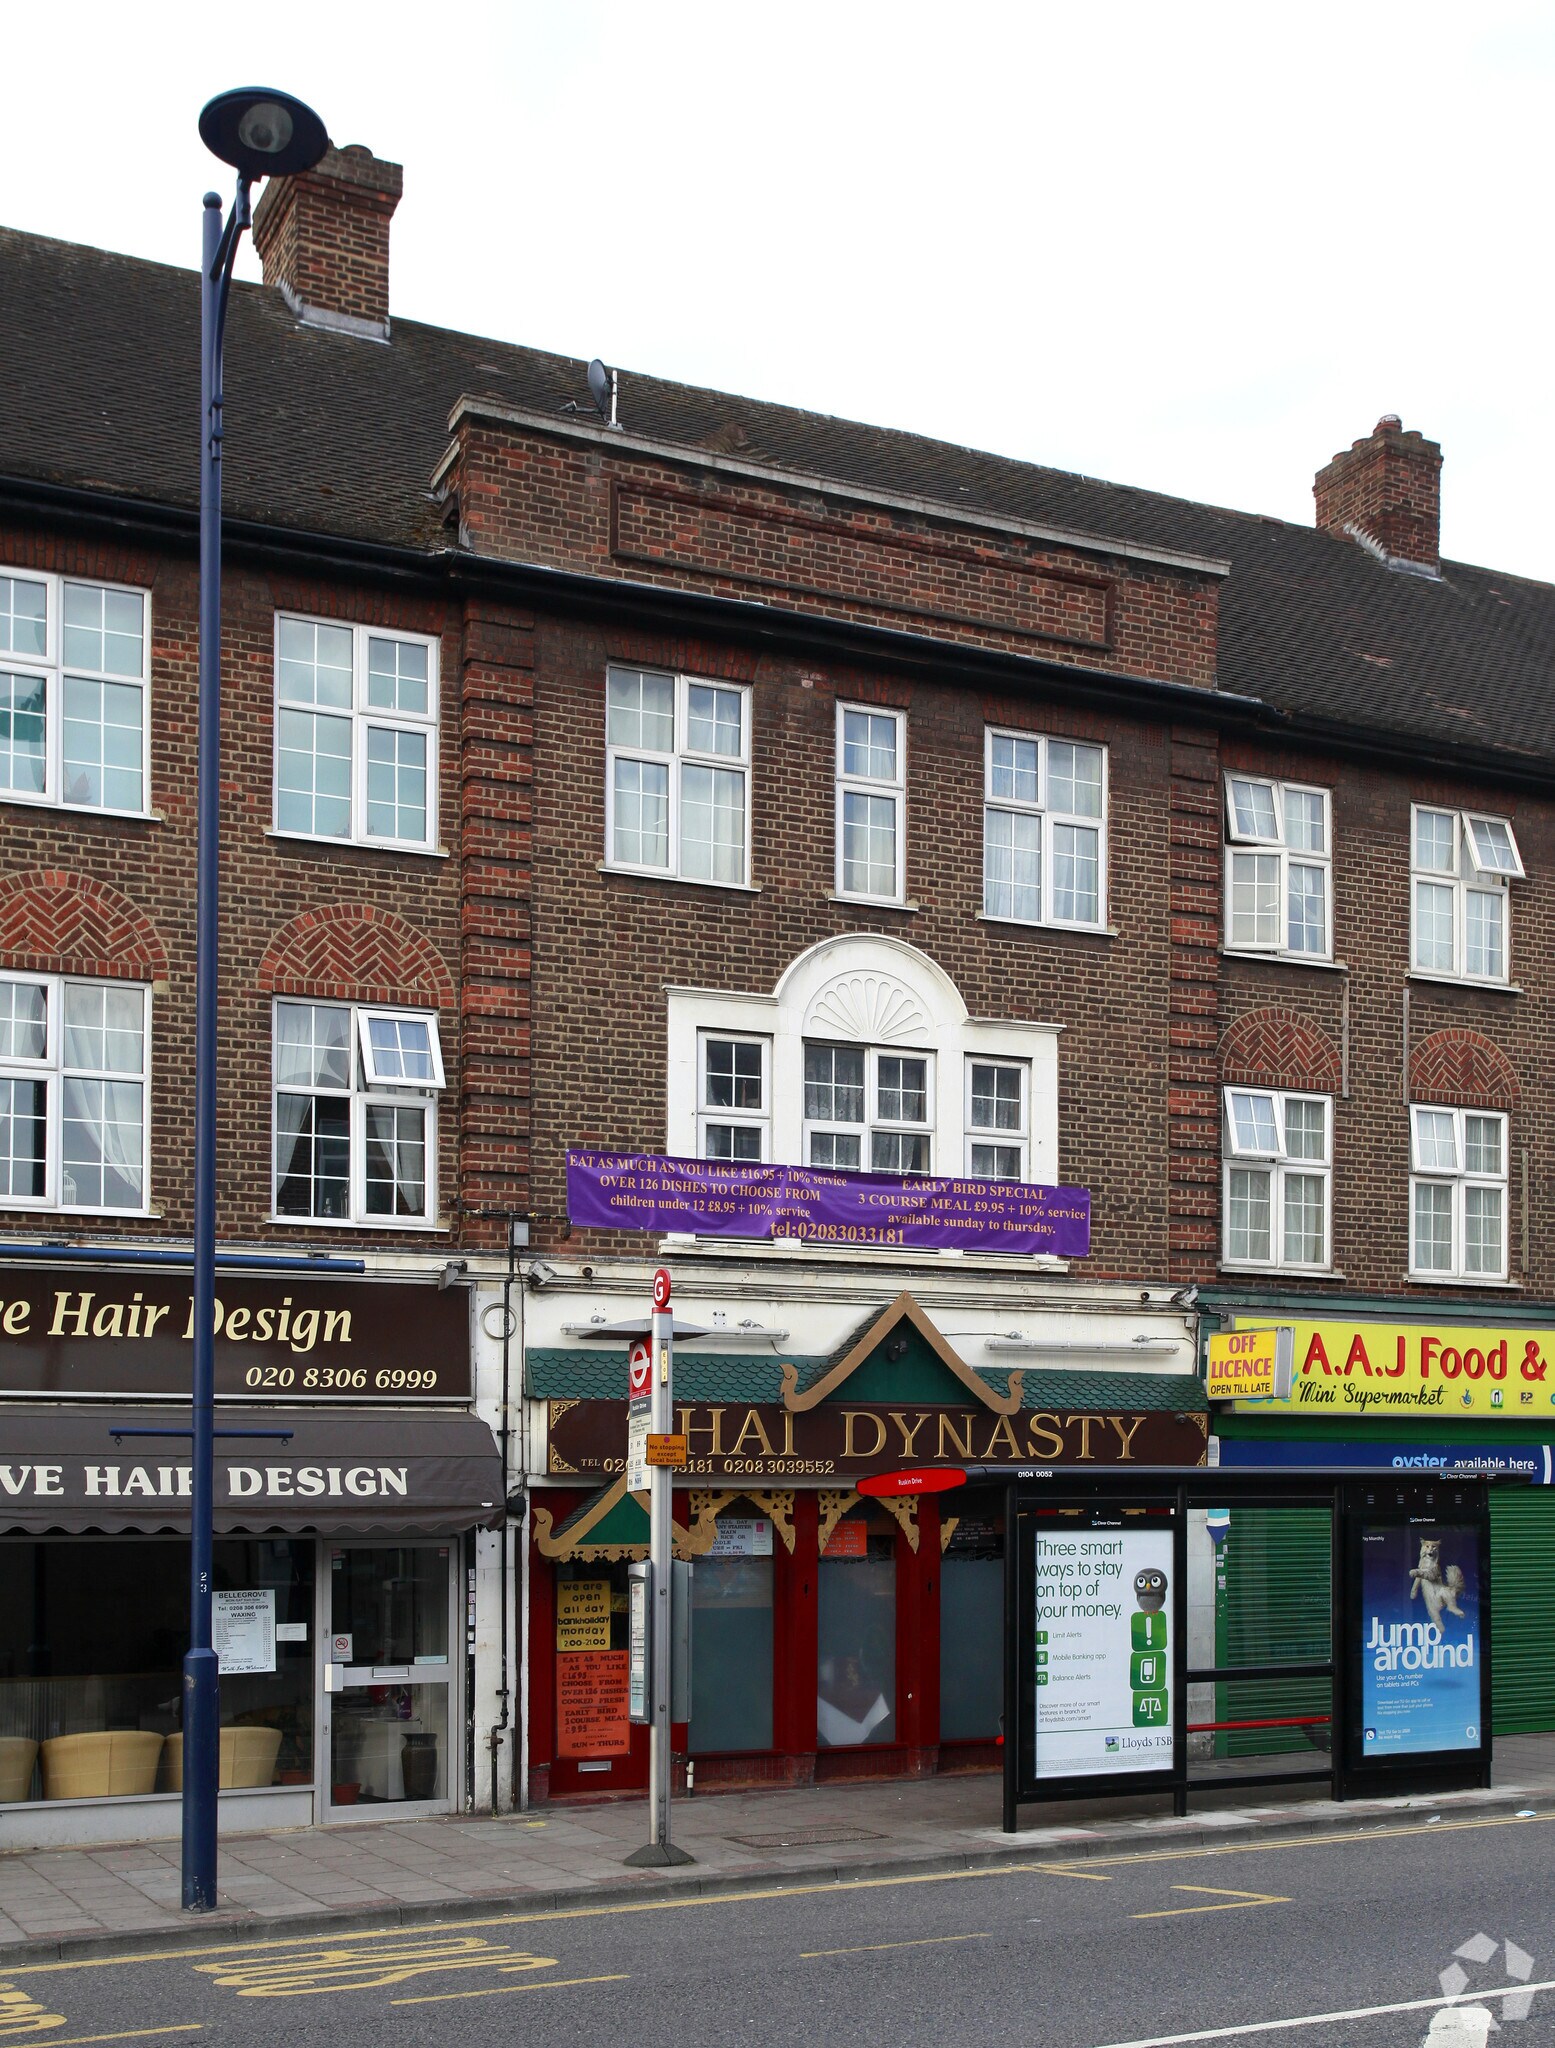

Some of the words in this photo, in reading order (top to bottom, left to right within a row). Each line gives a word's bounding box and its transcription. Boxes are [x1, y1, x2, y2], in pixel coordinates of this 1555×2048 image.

[569, 1154, 595, 1168] EAT
[597, 1157, 614, 1169] AS
[617, 1158, 657, 1172] MUCH
[659, 1162, 675, 1173] AS
[678, 1163, 705, 1176] YOU
[708, 1165, 738, 1178] LIKE
[741, 1168, 775, 1181] £16.95
[777, 1173, 784, 1181] +
[787, 1170, 811, 1183] 10%
[813, 1174, 848, 1187] service
[600, 1175, 636, 1189] OVER
[640, 1178, 658, 1190] 126
[662, 1179, 708, 1193] DISHES
[710, 1183, 728, 1195] TO
[730, 1184, 782, 1199] CHOOSE
[785, 1188, 821, 1201] FROM
[902, 1180, 950, 1194] EARLY
[953, 1182, 986, 1196] BIRD
[989, 1185, 1047, 1200] SPECIAL
[610, 1194, 655, 1208] children
[658, 1198, 690, 1210] under
[693, 1200, 705, 1211] 12
[708, 1200, 736, 1214] £8.95
[738, 1205, 746, 1213] +
[748, 1203, 773, 1216] 10%
[776, 1206, 811, 1218] service
[858, 1193, 866, 1205] 3
[869, 1193, 928, 1209] COURSE
[931, 1198, 972, 1211] MEAL
[974, 1201, 1005, 1214] £9.95
[1007, 1204, 1016, 1213] +
[1020, 1204, 1045, 1217] 10%
[1047, 1208, 1086, 1220] service
[770, 1221, 904, 1244] tel:02083033181
[888, 1213, 941, 1226] available
[943, 1216, 985, 1232] sunday
[988, 1219, 1000, 1231] to
[1003, 1220, 1056, 1236] thursday.
[654, 1276, 664, 1301] G
[0, 1300, 31, 1335] e
[47, 1292, 170, 1338] Hair
[1228, 1335, 1257, 1355] OFF
[1302, 1332, 1406, 1378] A.A.J
[1420, 1336, 1508, 1381] Food
[1520, 1339, 1548, 1382] &
[245, 1366, 295, 1388] 020
[302, 1367, 368, 1389] 8306
[375, 1369, 438, 1390] 6999
[1211, 1357, 1272, 1379] LICENCE
[1210, 1384, 1232, 1395] OPEN
[1234, 1383, 1249, 1394] TILL
[1251, 1382, 1271, 1393] LATE
[1299, 1381, 1337, 1403] Mini
[1343, 1382, 1449, 1413] Supermarket
[626, 1408, 799, 1456] HAI
[840, 1411, 1147, 1460] DYNASTY
[581, 1458, 601, 1467] TEL
[724, 1459, 763, 1475] 0208
[767, 1459, 835, 1475] 3039552
[1392, 1453, 1448, 1468] oyster
[1454, 1456, 1506, 1469] available
[1509, 1456, 1538, 1469] here.
[0, 1465, 65, 1496] VE
[227, 1466, 409, 1497] DESIGN
[1037, 1539, 1077, 1556] Three
[1080, 1540, 1123, 1556] smart
[1036, 1564, 1074, 1581] ways
[1077, 1561, 1091, 1576] to
[1094, 1560, 1123, 1579] stay
[218, 1590, 268, 1599] BELLEGROVE
[563, 1583, 580, 1591] we
[583, 1583, 603, 1591] are
[1036, 1585, 1055, 1598] on
[1059, 1582, 1083, 1601] top
[1085, 1579, 1100, 1597] of
[572, 1593, 601, 1602] open
[563, 1605, 580, 1614] all
[584, 1604, 605, 1613] day
[1036, 1605, 1068, 1623] your
[1071, 1604, 1122, 1620] money.
[560, 1627, 605, 1636] monday
[1366, 1616, 1443, 1655] Jump
[1072, 1653, 1094, 1662] Banking
[1095, 1653, 1107, 1661] app
[1373, 1633, 1474, 1672] around
[598, 1696, 625, 1704] FRESH
[600, 1687, 629, 1695] DISHES
[564, 1709, 590, 1717] EARLY
[597, 1707, 618, 1715] BIRD
[570, 1715, 601, 1723] COURSE
[604, 1714, 628, 1722] MEAL
[571, 1741, 588, 1749] SUN
[597, 1739, 625, 1747] THURS
[1122, 1736, 1153, 1751] Lloyds
[1154, 1735, 1173, 1746] TSB
